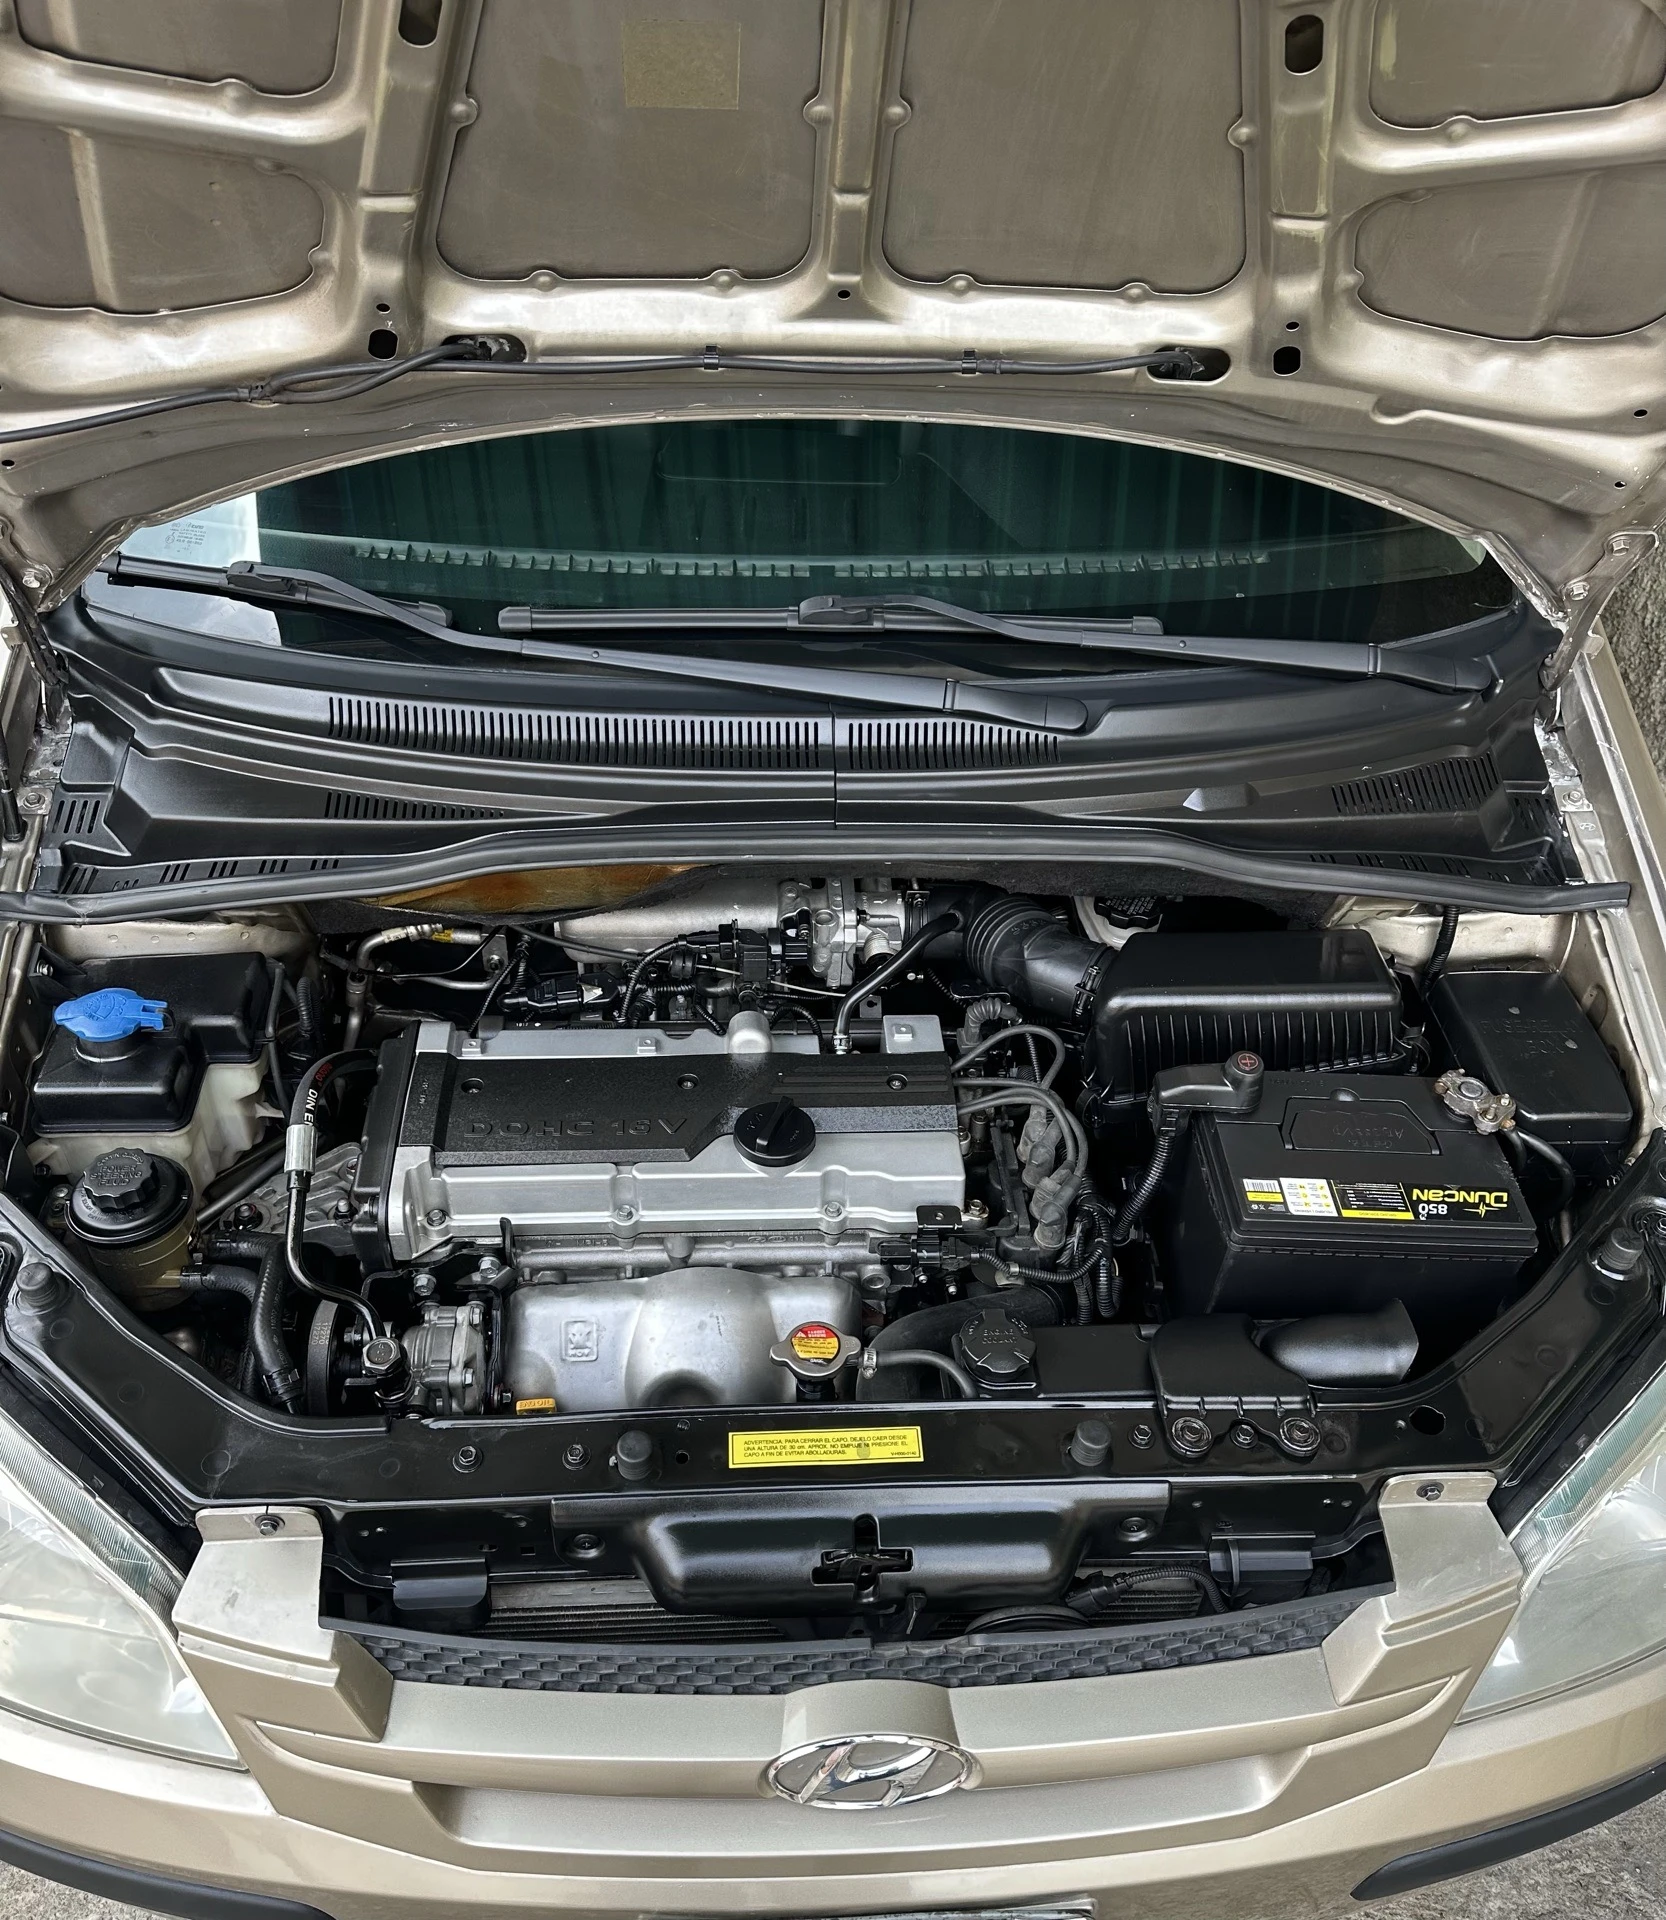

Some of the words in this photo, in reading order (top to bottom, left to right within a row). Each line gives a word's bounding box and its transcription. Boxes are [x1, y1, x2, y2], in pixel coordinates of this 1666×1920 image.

[305, 1088, 318, 1111] DIN
[464, 1117, 595, 1137] DOHC
[100, 1165, 138, 1173] POWER
[90, 1171, 142, 1180] STEERING
[98, 1178, 130, 1186] FLUID
[1418, 1203, 1448, 1215] 850
[983, 1328, 1014, 1336] ENGINE
